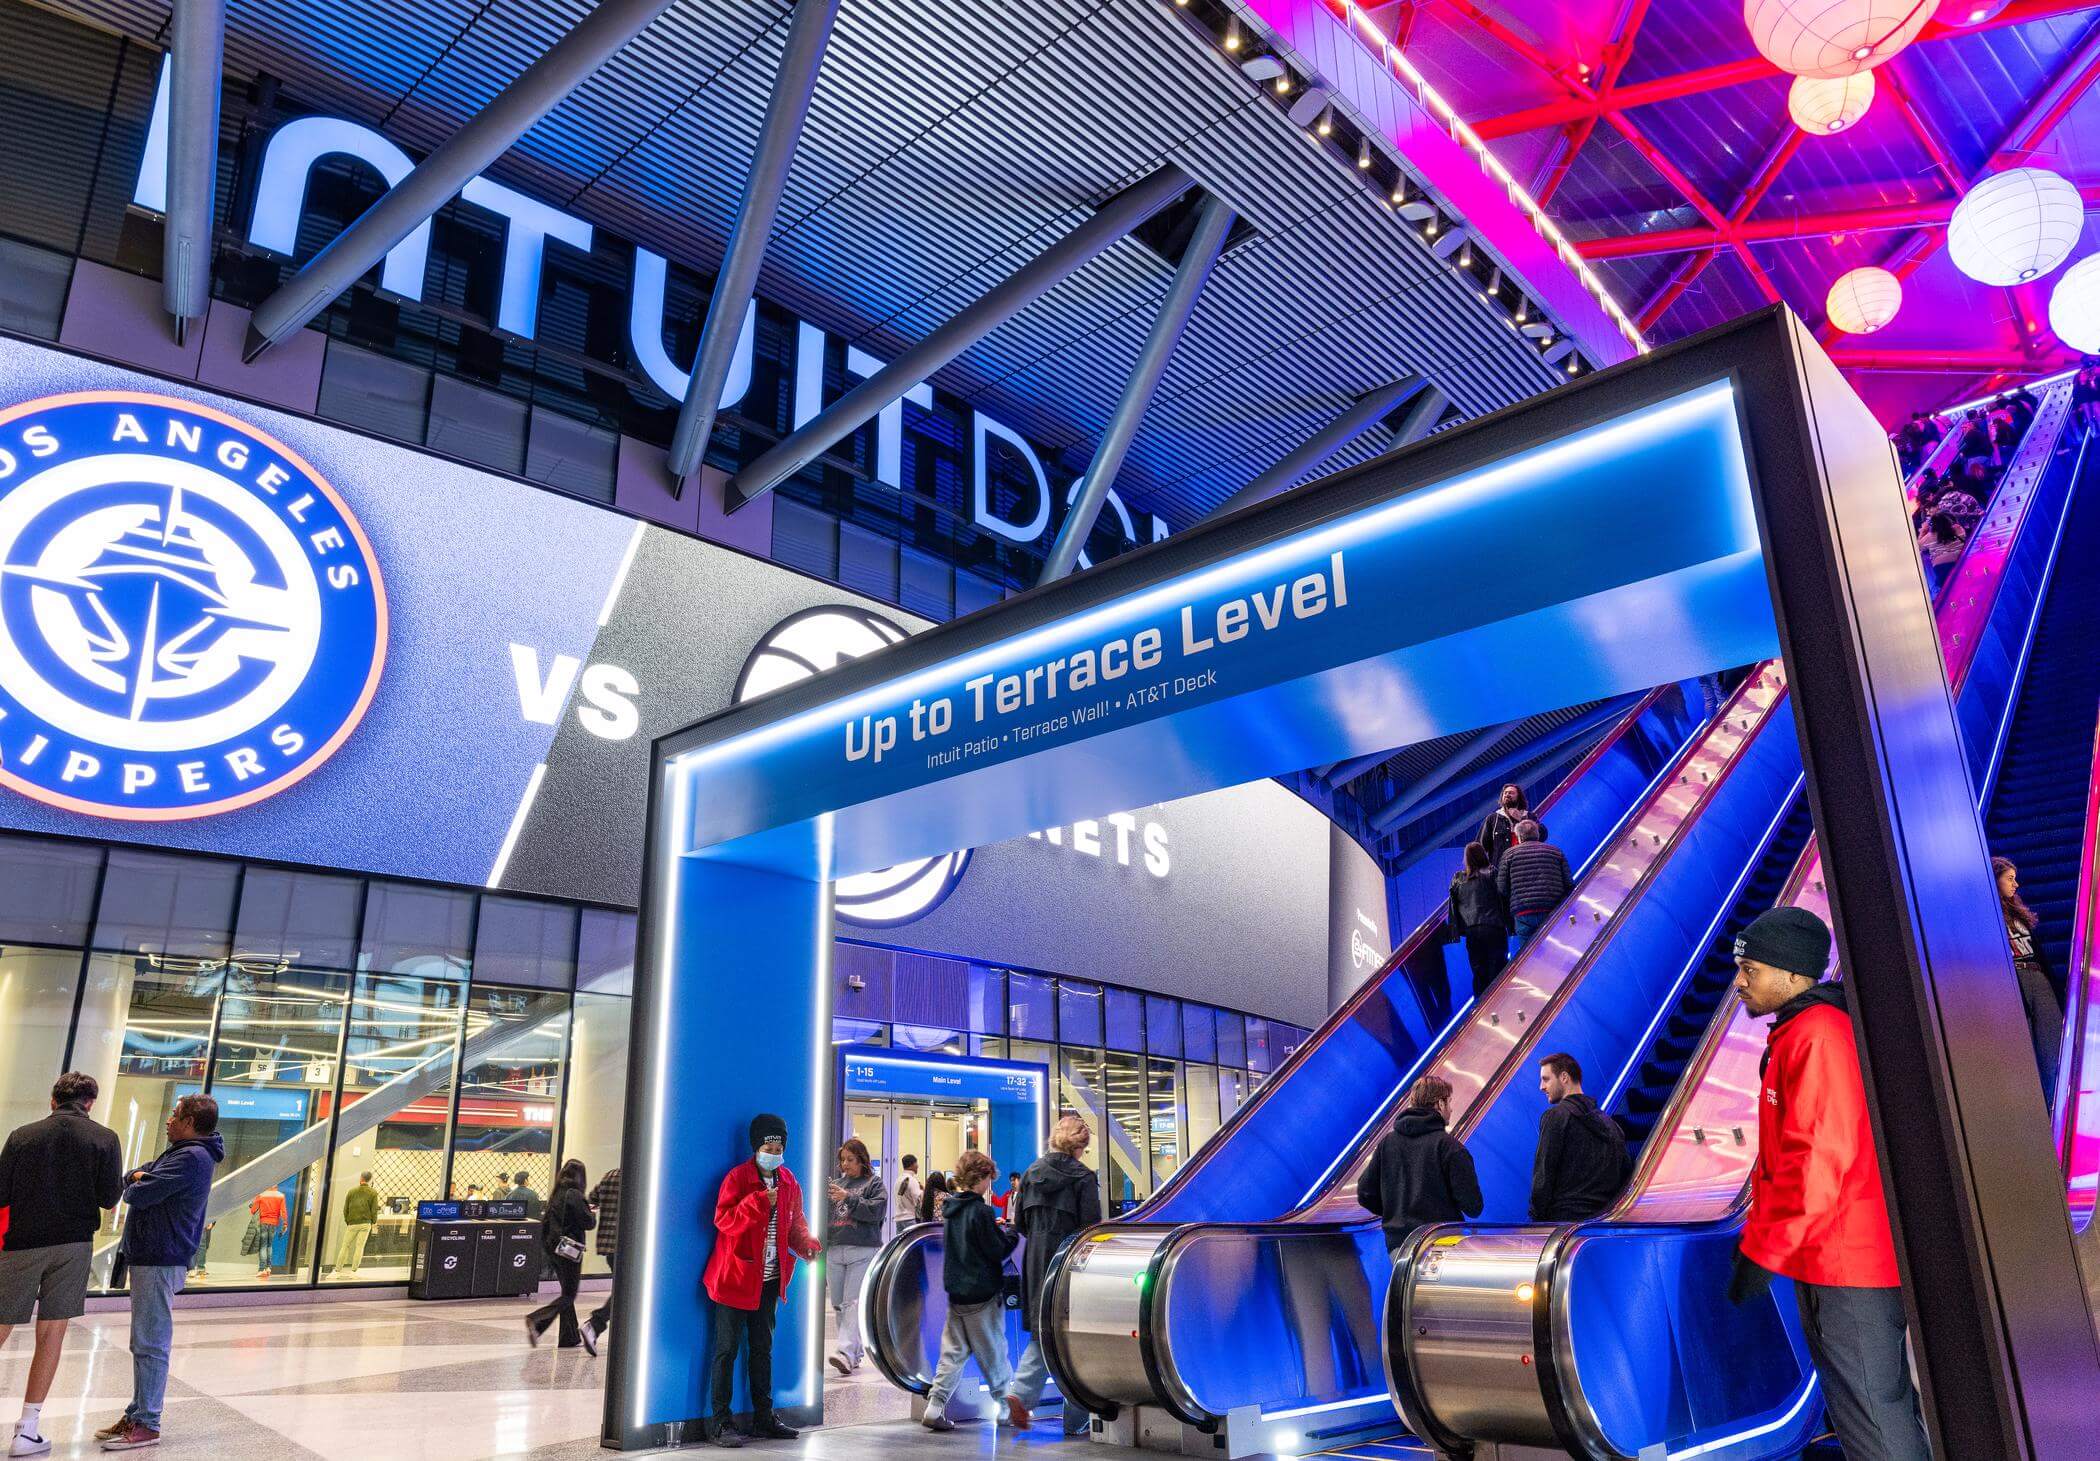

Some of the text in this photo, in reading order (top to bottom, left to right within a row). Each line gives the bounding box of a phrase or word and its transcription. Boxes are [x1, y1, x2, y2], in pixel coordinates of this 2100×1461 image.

[113, 414, 359, 589] ANGELES
[845, 551, 1348, 763] Up to Terrace Level
[0, 707, 305, 794] IPPERS
[927, 669, 1217, 769] Intuit Patio Terrace Wall! AT&T Deck
[857, 1067, 874, 1077] 1-15
[932, 1076, 961, 1085] Main Level
[1006, 1076, 1027, 1086] 17-32
